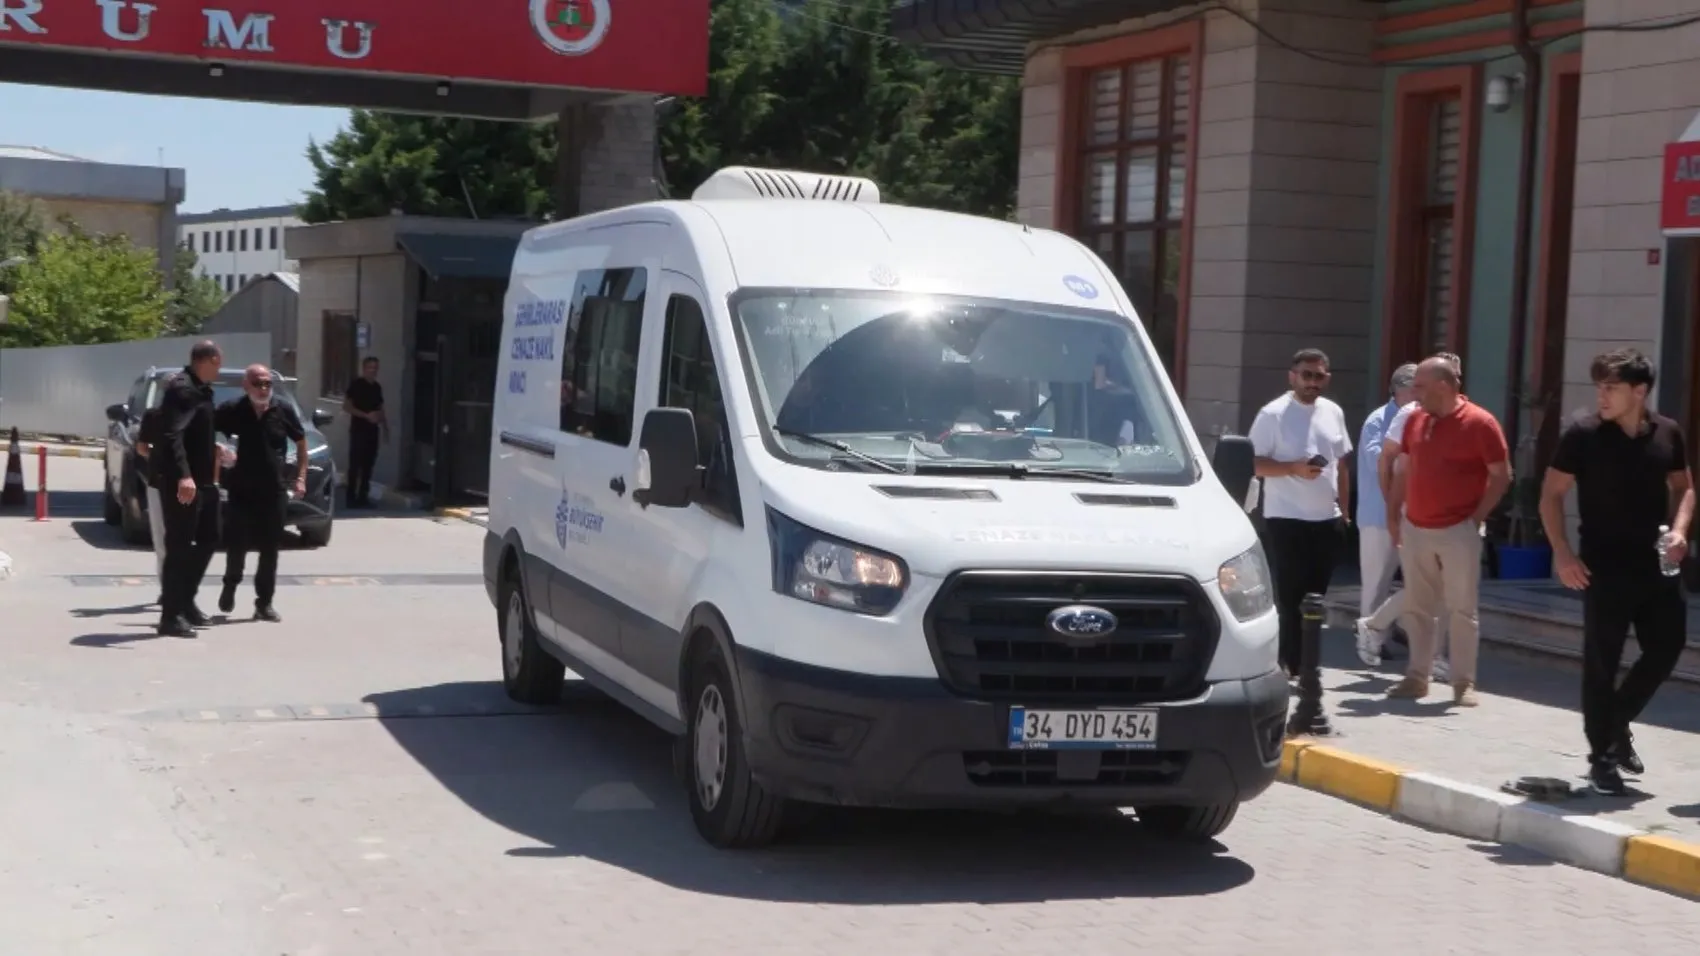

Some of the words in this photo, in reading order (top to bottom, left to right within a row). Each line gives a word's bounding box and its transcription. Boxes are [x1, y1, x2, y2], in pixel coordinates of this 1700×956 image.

[1068, 614, 1104, 633] Ford
[1026, 713, 1052, 739] 34
[1065, 714, 1105, 739] DYD
[1112, 714, 1152, 739] 454
